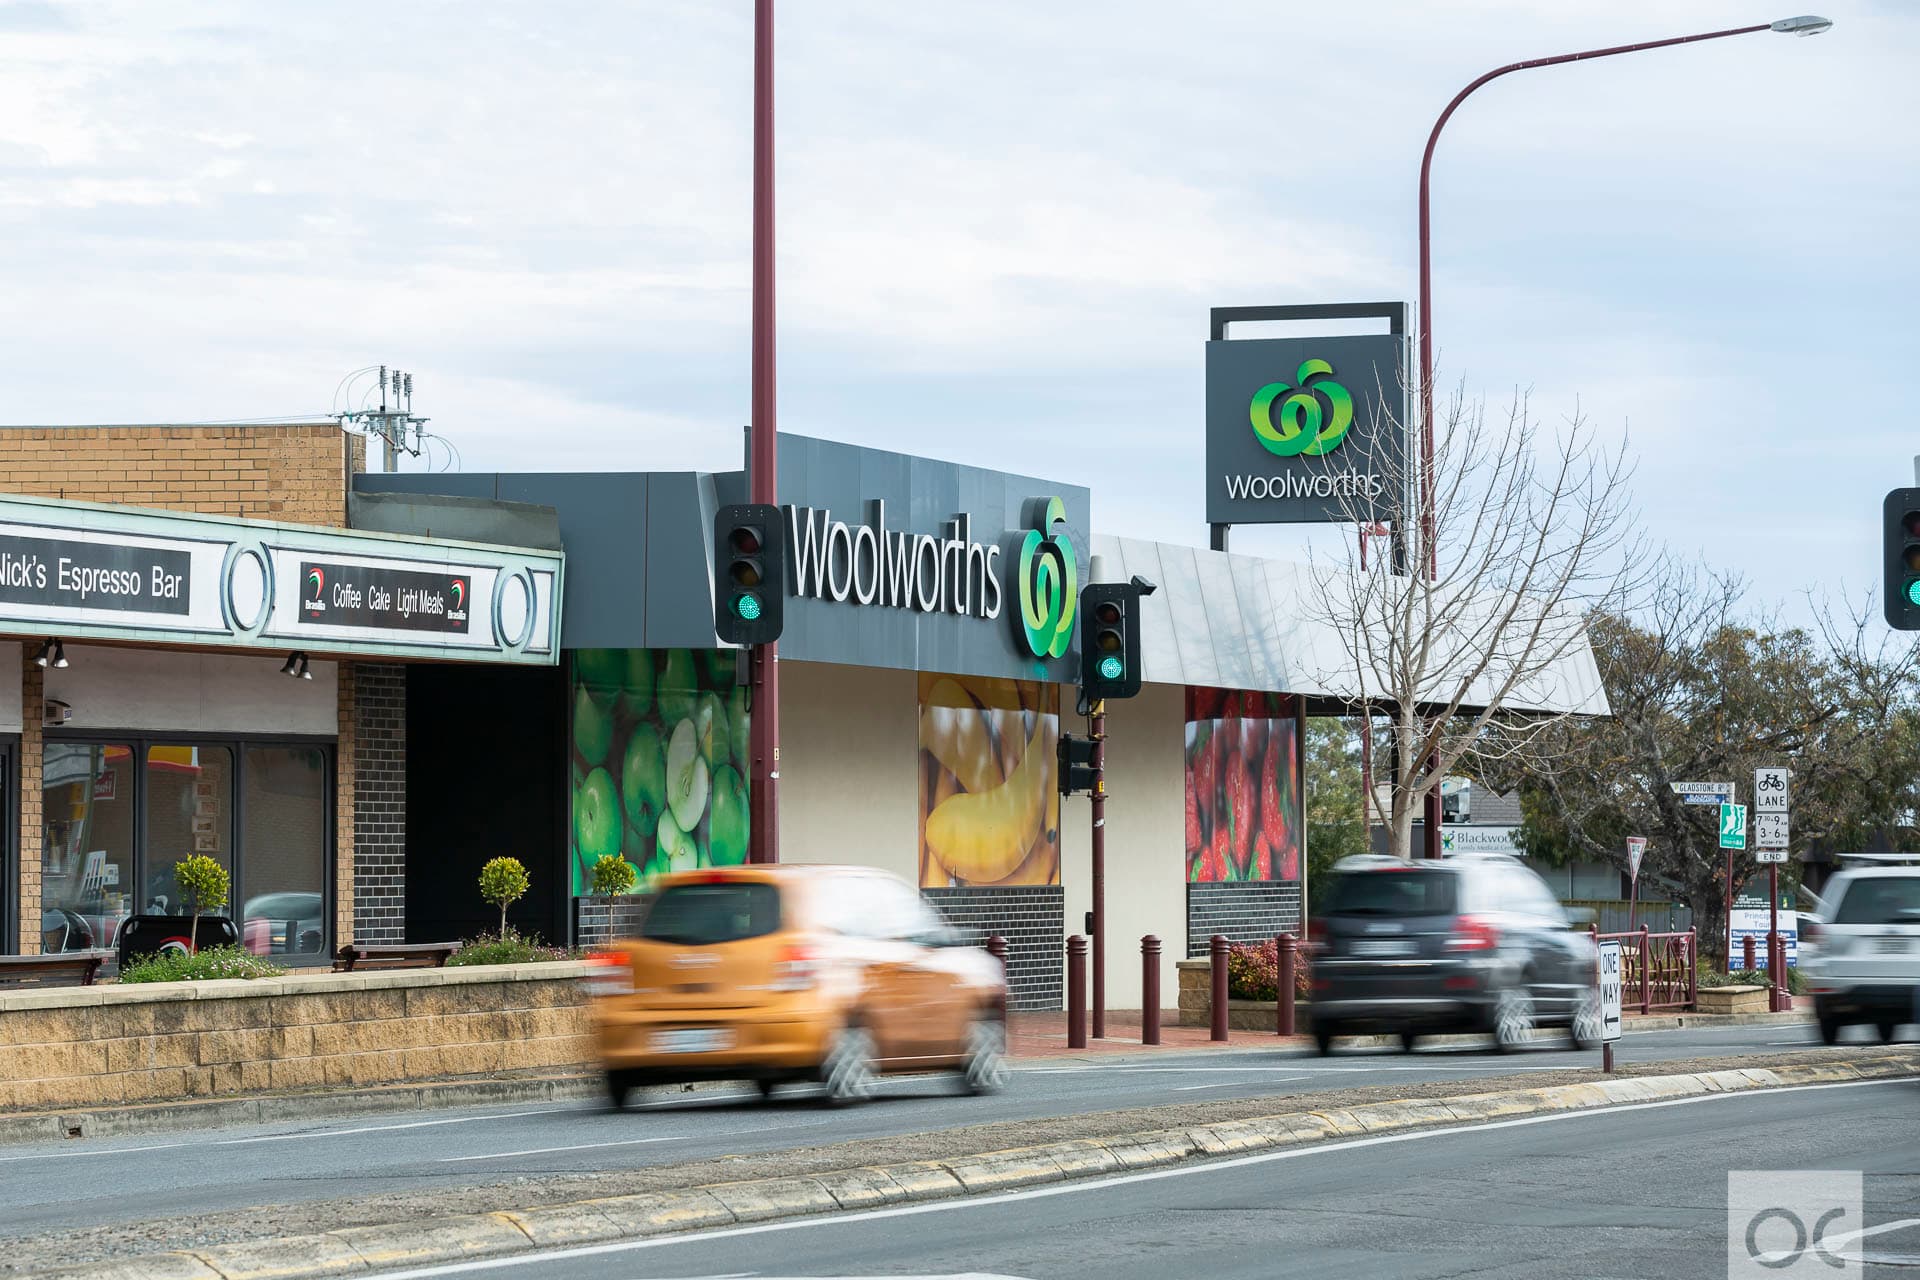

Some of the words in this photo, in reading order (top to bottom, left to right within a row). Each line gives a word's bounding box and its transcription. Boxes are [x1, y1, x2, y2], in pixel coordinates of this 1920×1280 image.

[1225, 468, 1383, 499] Woolworths
[784, 499, 1001, 620] Woolworths
[58, 557, 141, 599] Espresso
[151, 565, 182, 598] Bar
[333, 582, 361, 609] Coffee
[368, 585, 390, 611] Cake
[397, 587, 418, 618] Light
[419, 589, 444, 615] Meals
[1680, 783, 1714, 792] GLADSTONE
[1758, 796, 1785, 806] LANE
[1760, 827, 1766, 838] 3
[1774, 828, 1780, 838] 6
[1603, 953, 1617, 975] ONE
[1603, 982, 1619, 1004] WAY
